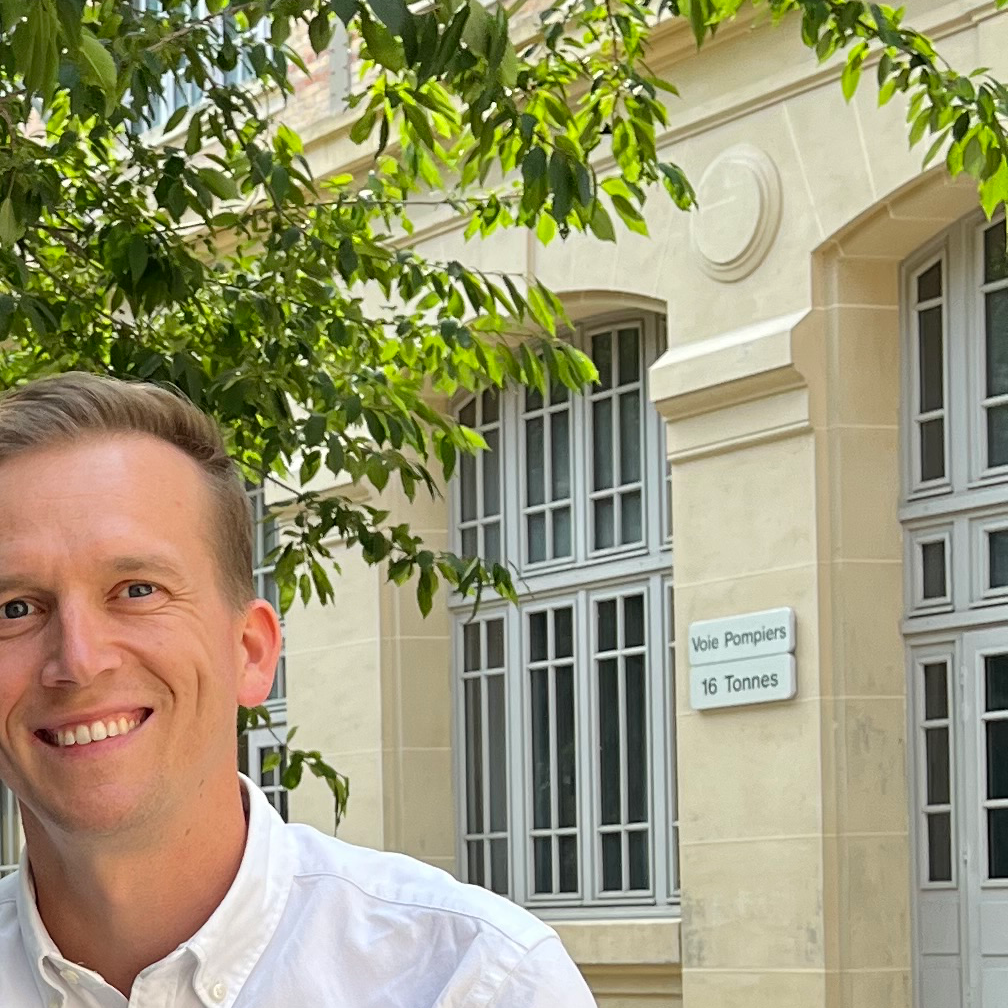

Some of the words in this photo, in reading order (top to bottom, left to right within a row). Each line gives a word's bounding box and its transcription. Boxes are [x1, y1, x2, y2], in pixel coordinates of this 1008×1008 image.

[692, 635, 719, 652] Voie
[724, 625, 787, 648] Pompiers
[702, 677, 718, 696] 16
[724, 673, 779, 693] Tonnes
